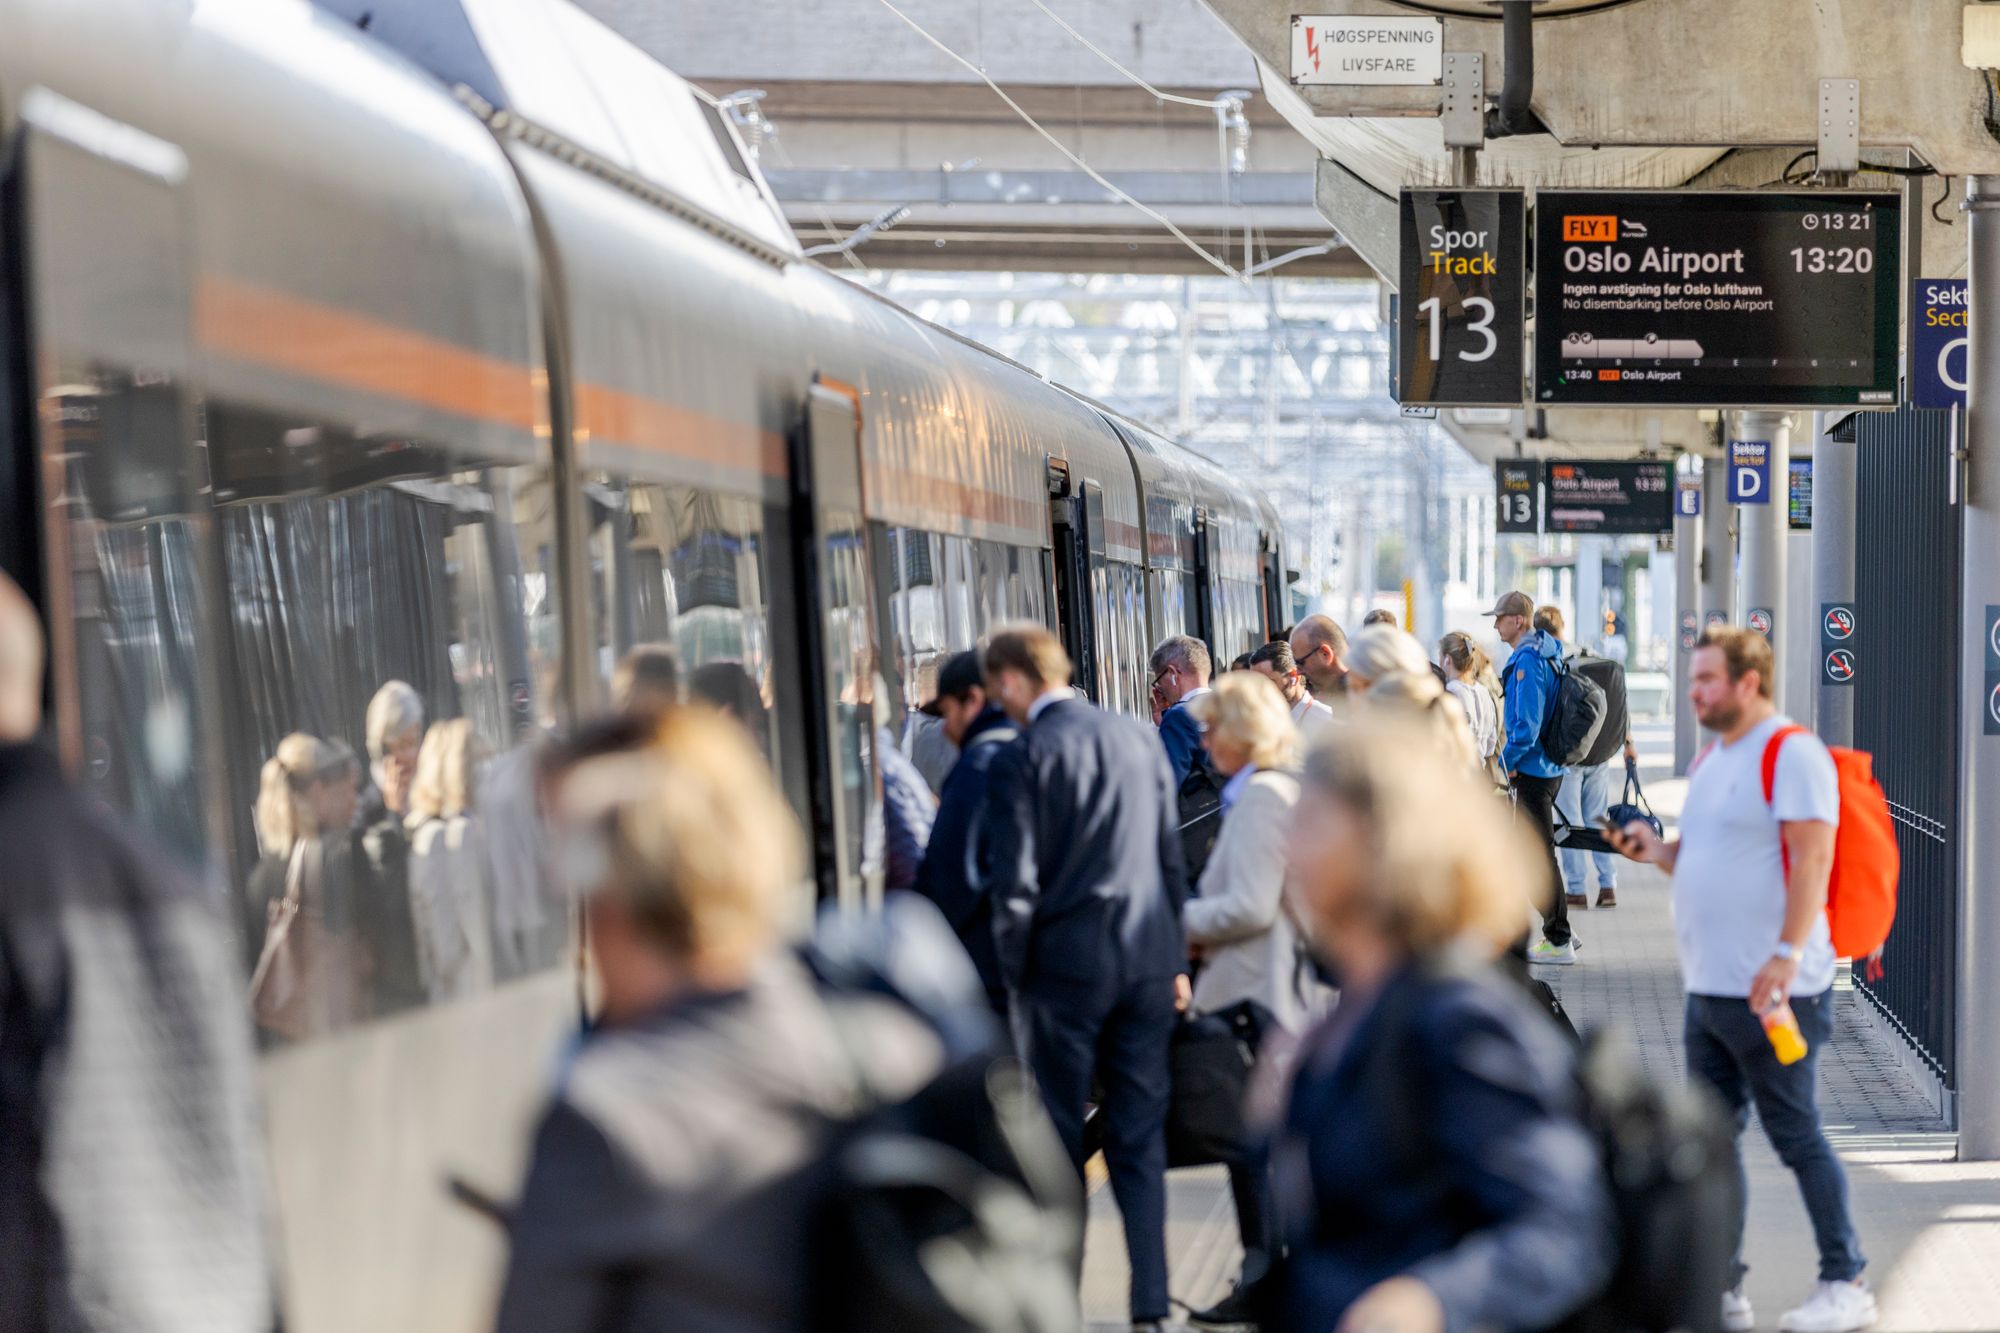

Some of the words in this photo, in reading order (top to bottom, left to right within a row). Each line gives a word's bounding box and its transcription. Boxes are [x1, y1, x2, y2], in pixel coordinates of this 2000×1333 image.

[1324, 29, 1435, 44] HØGSPENNING
[1341, 58, 1416, 72] LIVSFARE
[1570, 221, 1598, 236] FLY
[1602, 221, 1609, 236] 1
[1822, 213, 1844, 230] 13
[1849, 213, 1870, 230] 21
[1429, 224, 1489, 254] Spor
[1428, 250, 1498, 276] Track
[1564, 246, 1631, 273] Oslo
[1639, 246, 1744, 279] Airport
[1790, 247, 1872, 273] 13:20
[1563, 283, 1598, 297] Ingen
[1599, 283, 1662, 298] avstigning
[1663, 283, 1681, 295] før
[1683, 283, 1712, 295] Oslo
[1713, 283, 1763, 295] lufthavn
[1563, 298, 1581, 310] No
[1583, 298, 1662, 313] disembarking
[1664, 298, 1702, 311] before
[1704, 298, 1731, 310] Oslo
[1733, 298, 1774, 314] Airport
[1418, 296, 1498, 362] 13
[1564, 370, 1592, 380] 13:40
[1621, 370, 1645, 380] Oslo
[1646, 370, 1682, 382] Airport
[1737, 467, 1761, 497] D
[1500, 493, 1532, 523] 13
